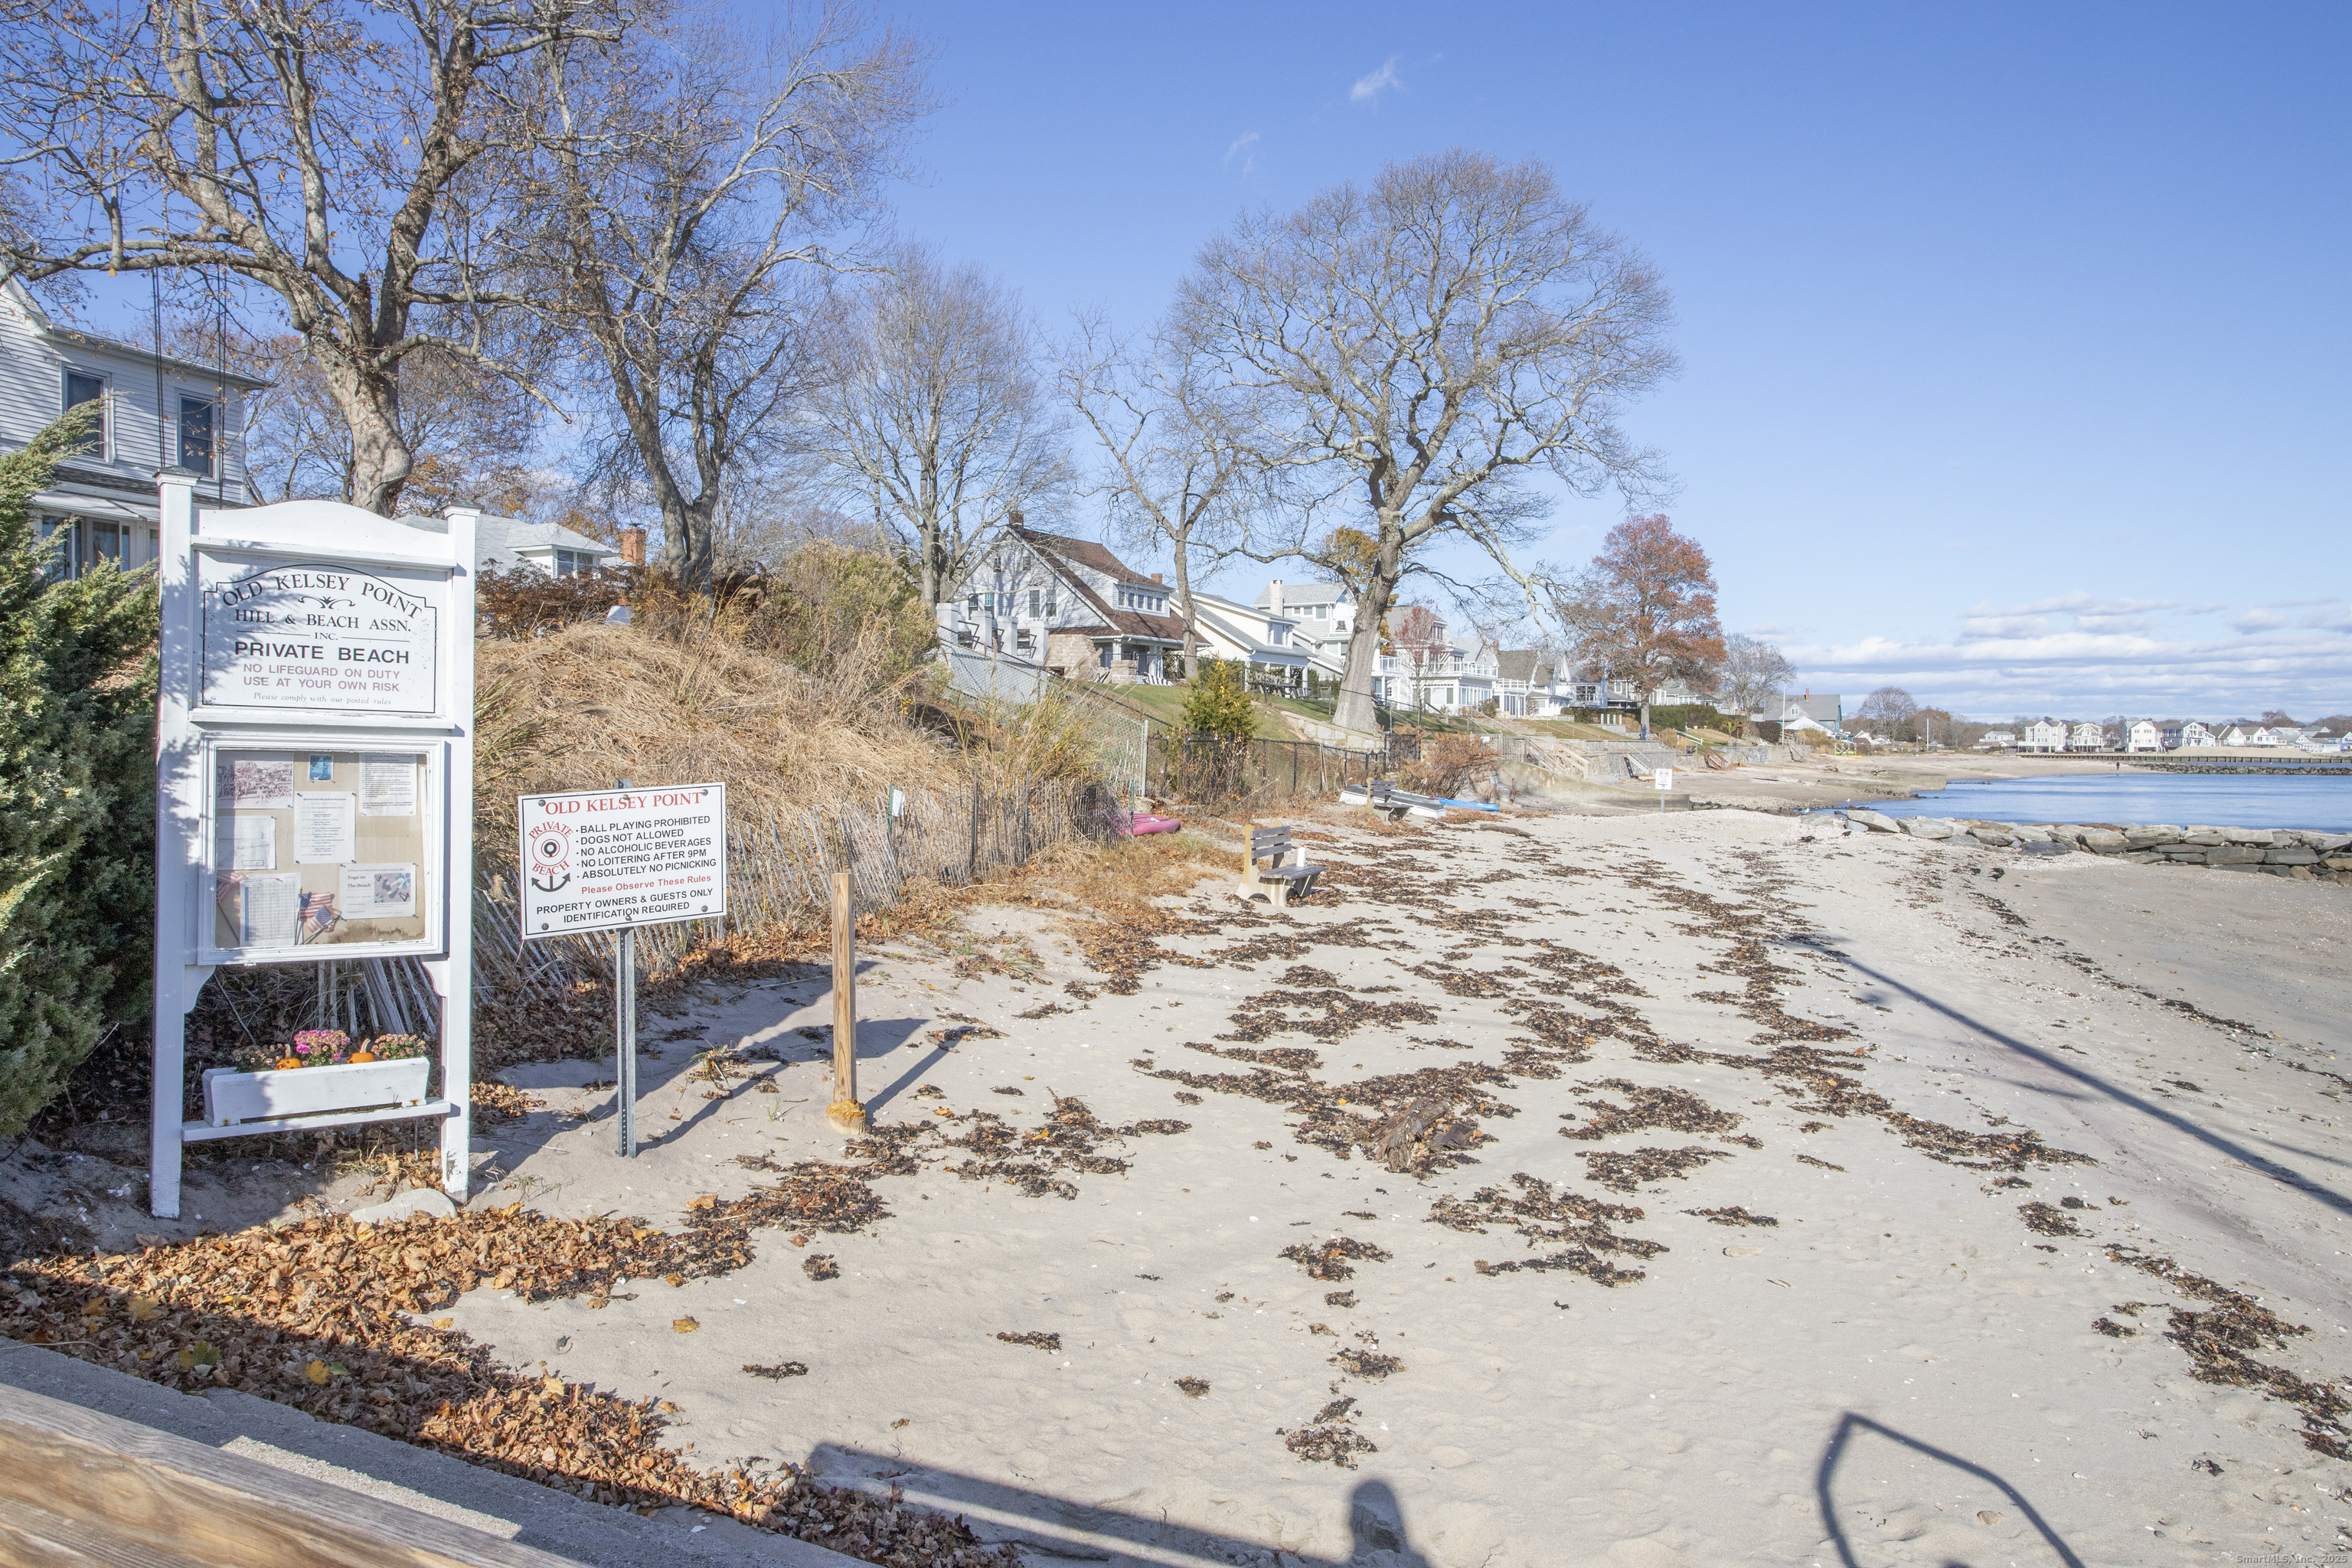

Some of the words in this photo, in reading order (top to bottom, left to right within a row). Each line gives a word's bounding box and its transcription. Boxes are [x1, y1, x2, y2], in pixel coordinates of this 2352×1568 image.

[223, 582, 263, 606] OLD
[275, 574, 350, 590] KELSEY
[361, 582, 422, 619] POINT
[235, 609, 275, 623] HILL
[285, 614, 296, 625] &
[307, 614, 359, 629] BEACH
[369, 619, 410, 632] ASSN.
[315, 632, 338, 640] INC.
[234, 642, 324, 659] PRIVATE
[338, 647, 409, 664] BEACH
[243, 663, 262, 673] NO
[270, 665, 338, 676] LIFEGUARD
[345, 668, 361, 678] ON
[368, 670, 400, 679] DUTY
[243, 676, 269, 686] USE
[276, 678, 291, 687] AT
[299, 679, 332, 688] YOUR
[338, 681, 367, 690] OWN
[373, 682, 400, 691] RISK
[545, 801, 580, 815] OLD
[586, 796, 647, 812] KELSEY
[653, 792, 703, 808] POINT
[528, 821, 573, 839] PRIVATE
[580, 824, 607, 834] BALL
[609, 820, 652, 831] PLAYING
[654, 815, 710, 828] PROHIBITED
[580, 835, 610, 844] DOGS
[612, 833, 633, 842] NOT
[635, 828, 684, 841] ALLOWED
[580, 848, 595, 856] NO
[598, 842, 653, 855] ALCOHOLIC
[655, 838, 711, 850] BEVERAGES
[581, 859, 596, 867] NO
[598, 854, 651, 867] LOITERING
[653, 851, 685, 861] AFTER
[688, 848, 707, 858] 9PM
[531, 860, 570, 876] BEACH
[582, 865, 647, 880] ABSOLUTELY
[649, 864, 663, 873] NO
[665, 858, 717, 871] PICNICKING
[581, 886, 612, 894] Please
[616, 881, 655, 891] Observe
[658, 878, 684, 887] These
[687, 875, 711, 884] Rules
[537, 901, 591, 915] PROPERTY
[595, 896, 637, 908] OWNERS
[640, 895, 647, 903] &
[650, 890, 688, 902] GUESTS
[690, 888, 713, 897] ONLY
[564, 906, 639, 923] IDENTIFICATION
[642, 902, 690, 914] REQUIRED
